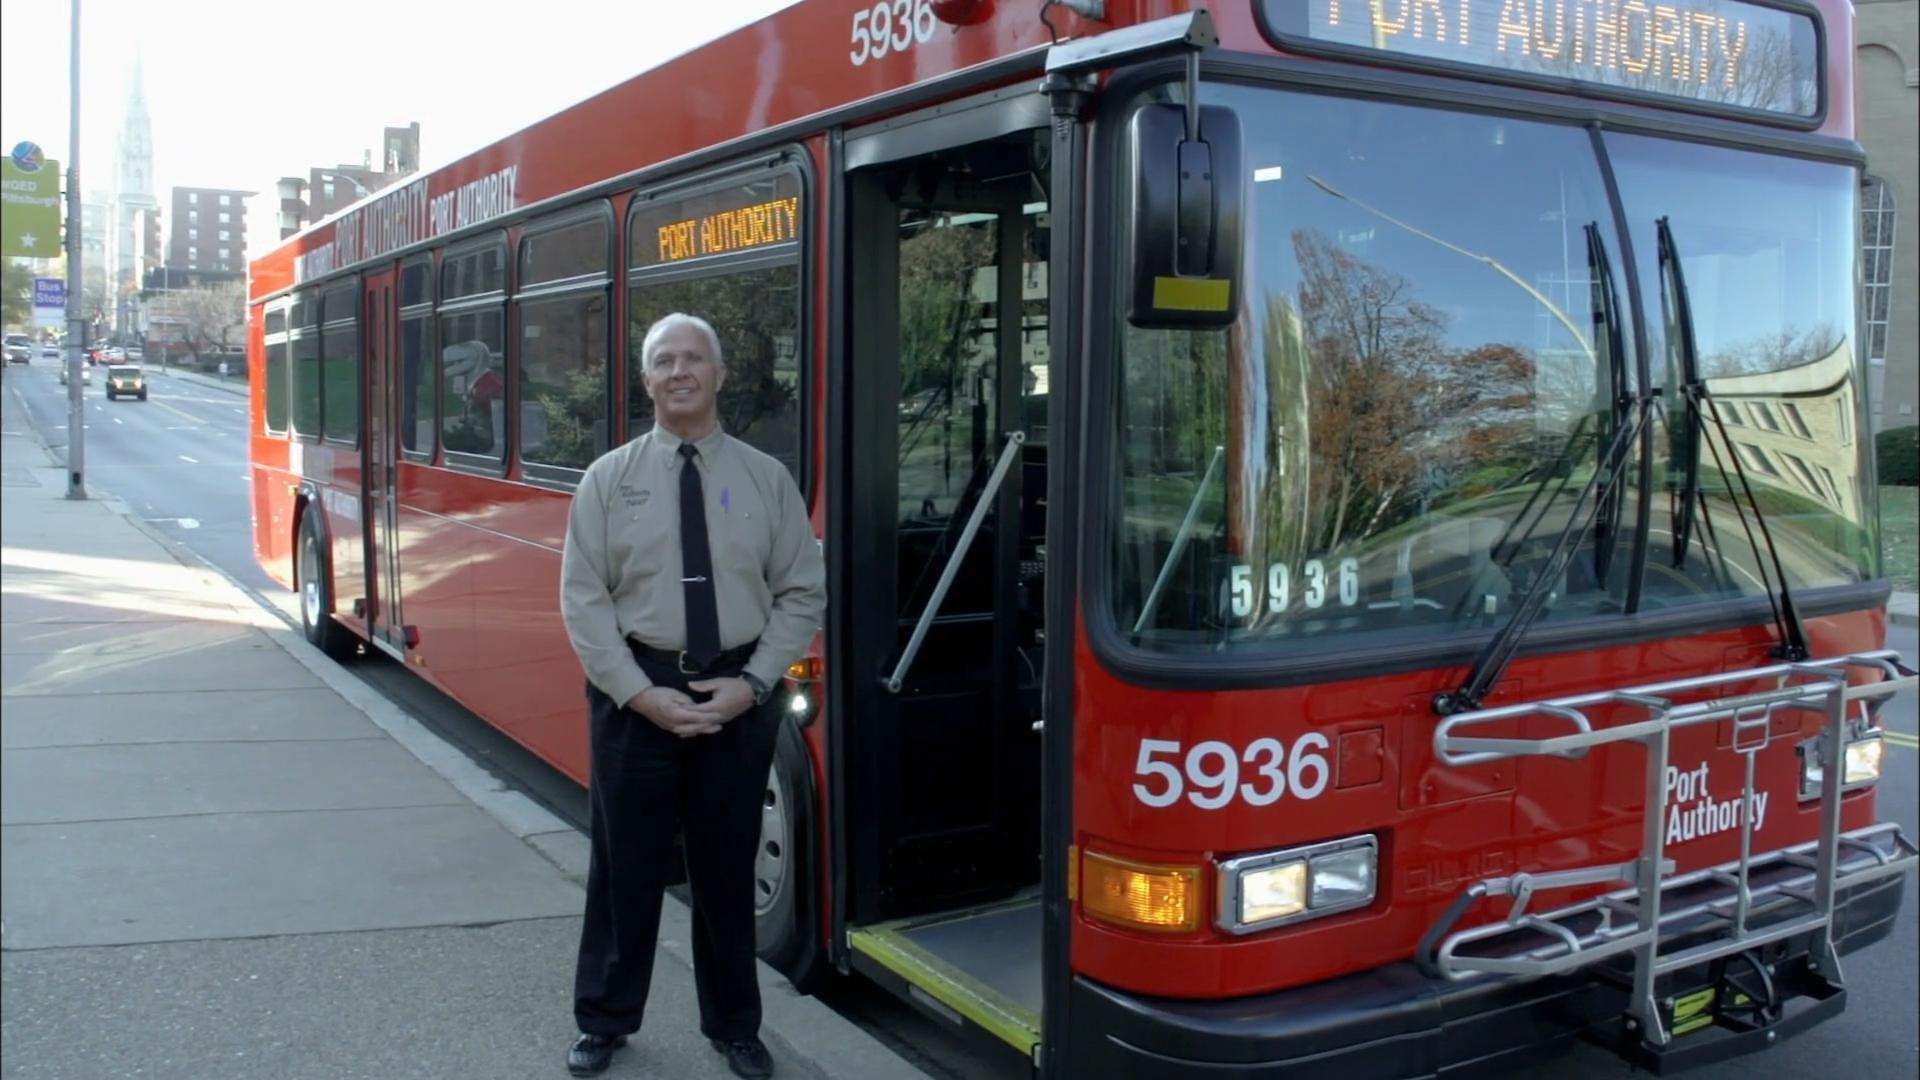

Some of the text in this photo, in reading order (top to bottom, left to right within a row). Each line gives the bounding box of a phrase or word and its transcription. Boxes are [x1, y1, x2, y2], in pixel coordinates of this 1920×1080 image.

[850, 0, 937, 67] 5936
[1497, 0, 1747, 89] AUTHORITY
[430, 164, 518, 239] PORT AUTHORITY
[658, 197, 798, 262] PORT AUTHORITY
[37, 292, 64, 305] Stop
[38, 281, 60, 291] Bus
[1132, 731, 1330, 810] 5936
[1664, 760, 1709, 807] Port
